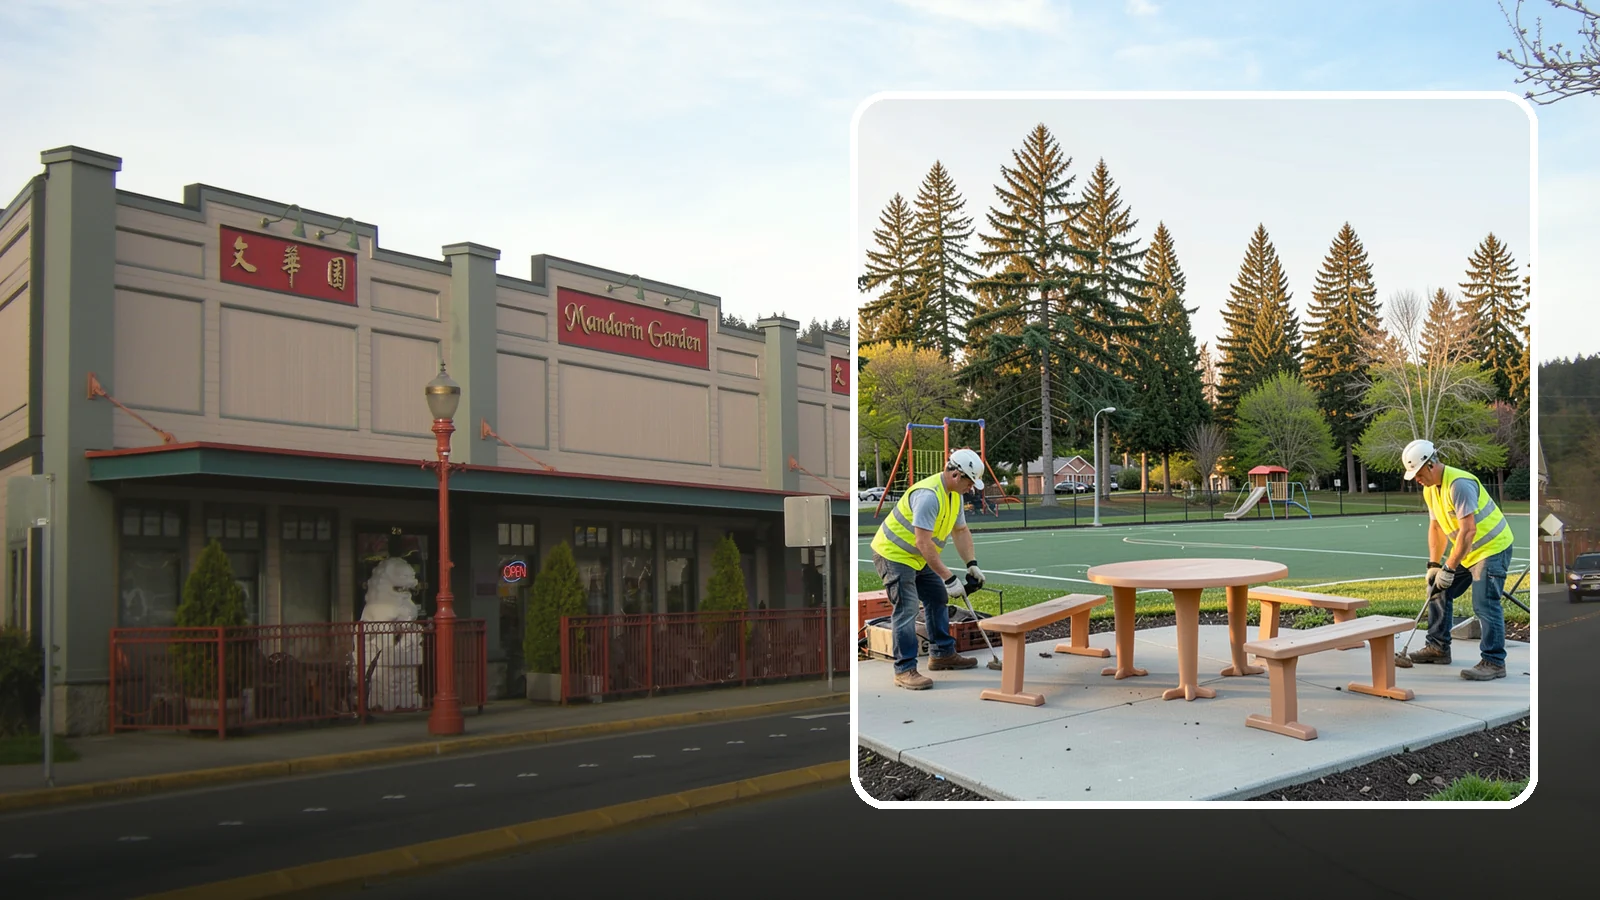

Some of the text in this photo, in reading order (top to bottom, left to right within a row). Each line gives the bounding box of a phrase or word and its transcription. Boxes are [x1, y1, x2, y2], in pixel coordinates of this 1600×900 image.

[231, 235, 346, 291] 文華園
[564, 302, 701, 352] Mandarin Garden
[503, 565, 527, 578] OPEN
